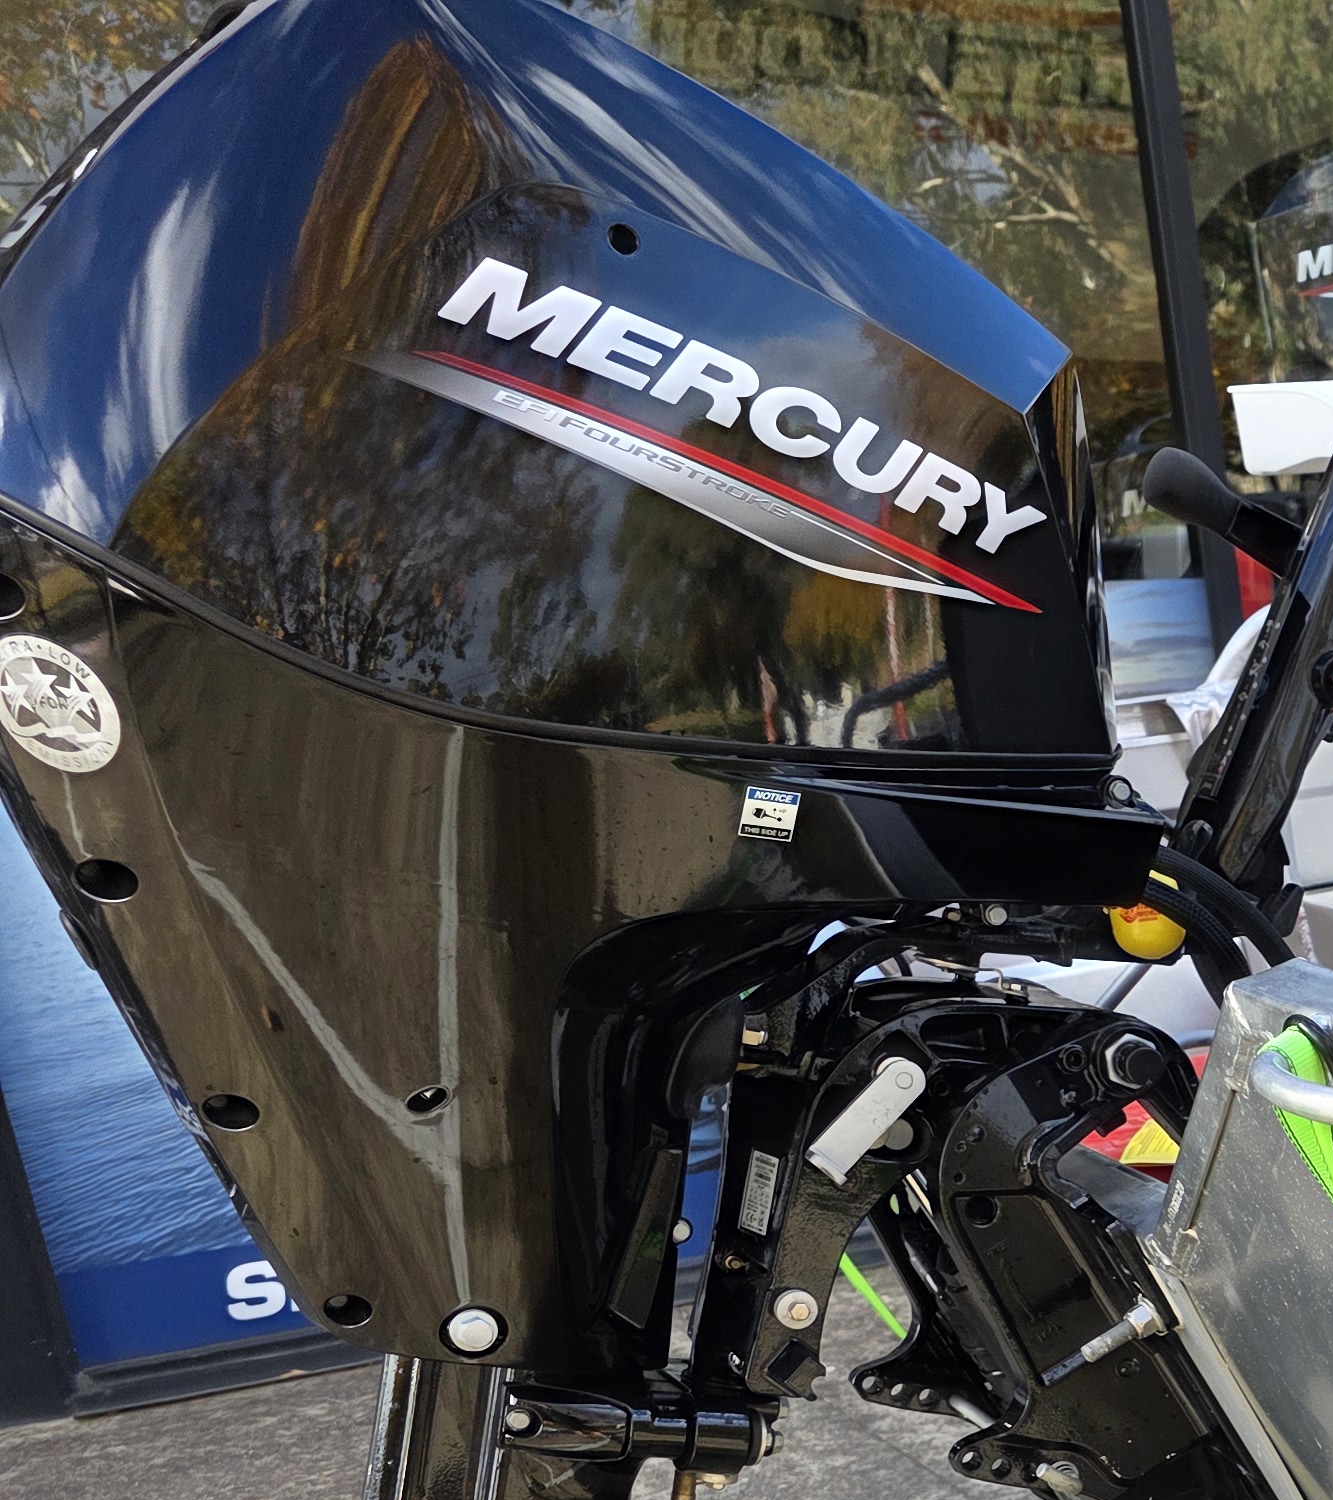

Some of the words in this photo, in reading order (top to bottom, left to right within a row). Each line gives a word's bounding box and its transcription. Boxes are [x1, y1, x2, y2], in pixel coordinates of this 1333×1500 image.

[437, 256, 1047, 555] MERCURY
[558, 415, 791, 519] FOURSTROKE
[50, 646, 91, 680] LOW
[753, 790, 794, 803] NOTICE
[744, 826, 760, 834] THIS
[761, 828, 777, 836] SIDE
